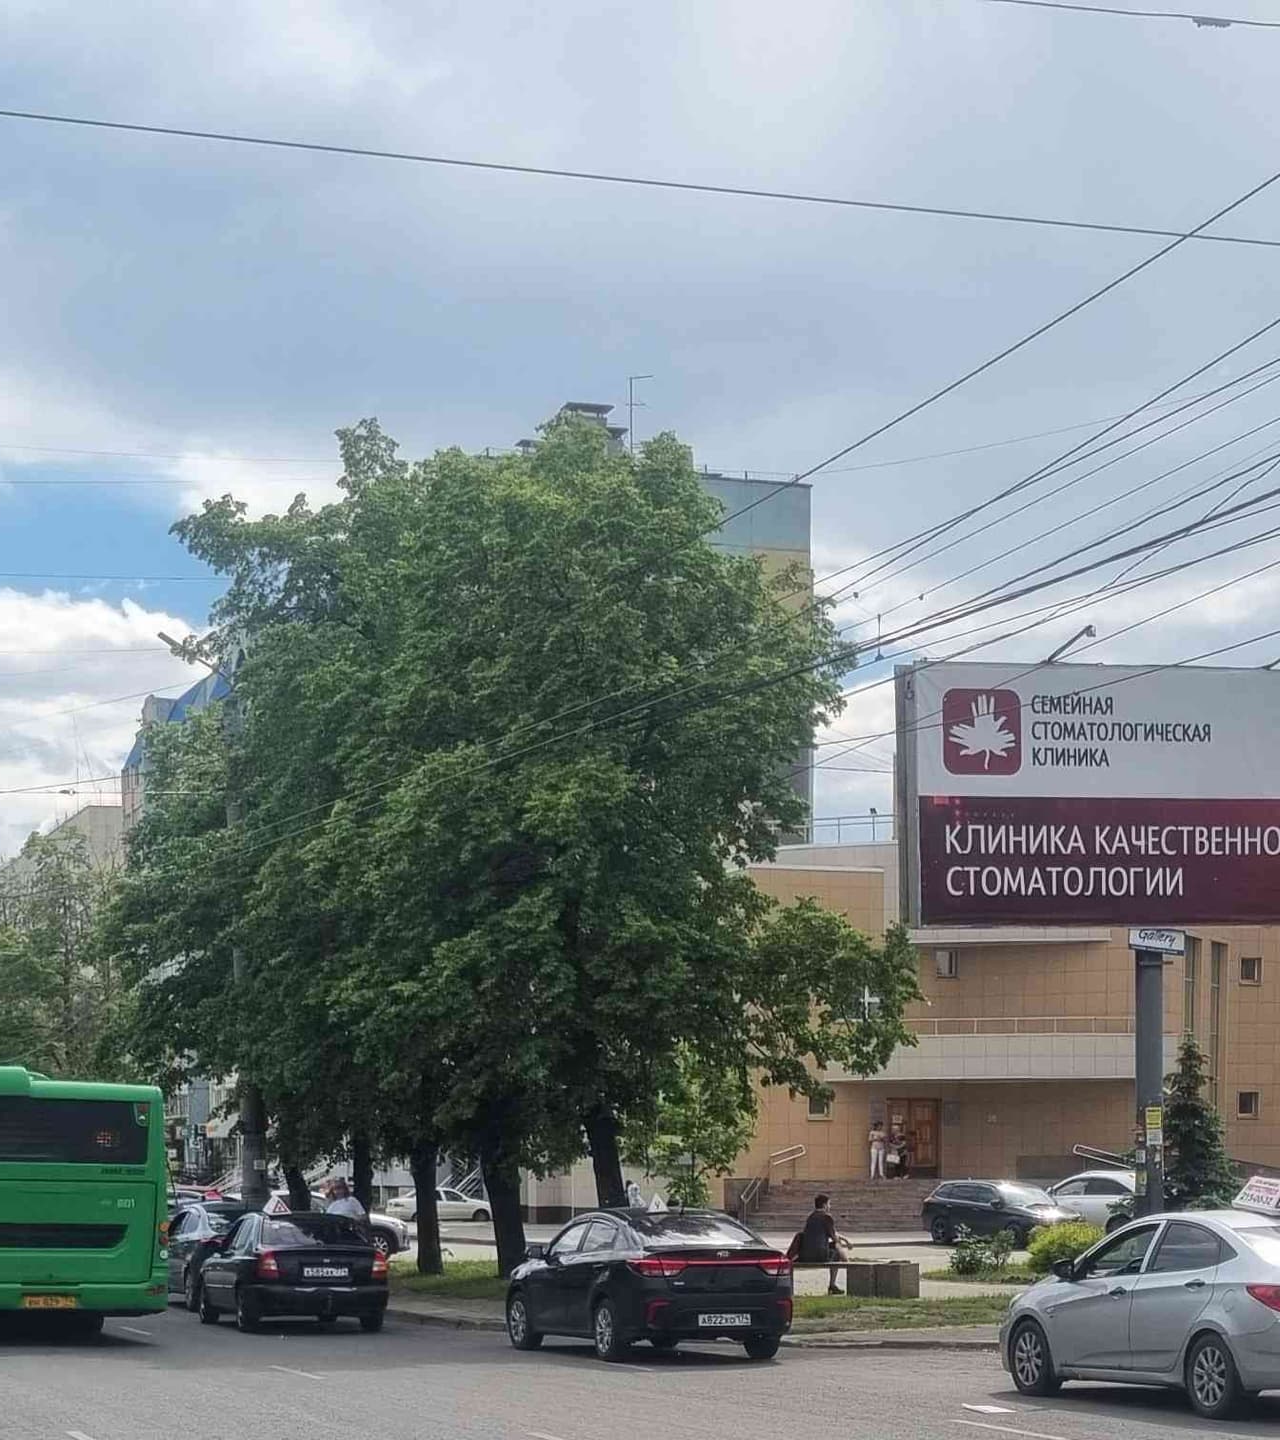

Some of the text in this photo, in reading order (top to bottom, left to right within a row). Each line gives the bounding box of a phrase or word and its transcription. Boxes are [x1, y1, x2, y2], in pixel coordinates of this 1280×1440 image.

[1031, 691, 1113, 715] СЕМЕЙНАЯ
[1031, 721, 1212, 742] СТОМАТОЛОГИЧЕСКАЯ
[1031, 747, 1110, 767] КЛИНИКА
[945, 823, 1086, 855] КЛИНИКА
[946, 866, 1184, 896] СТОМАТОЛОГИИ
